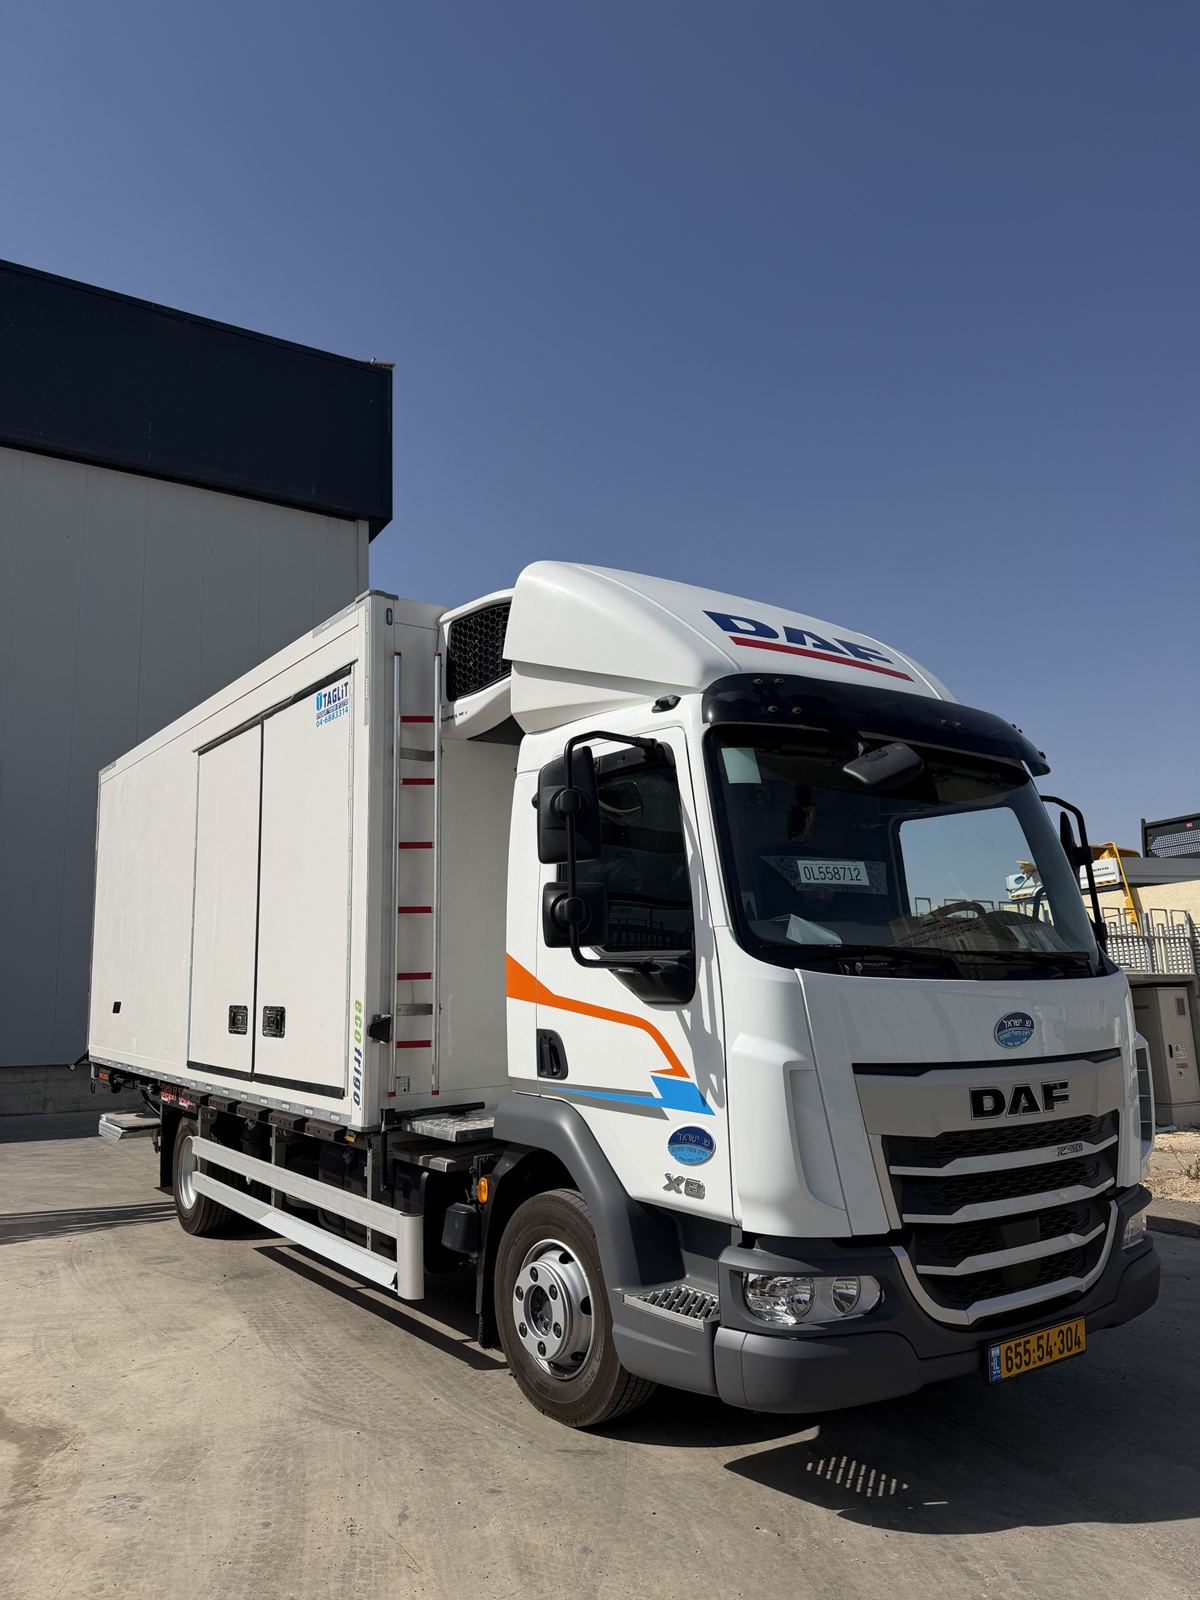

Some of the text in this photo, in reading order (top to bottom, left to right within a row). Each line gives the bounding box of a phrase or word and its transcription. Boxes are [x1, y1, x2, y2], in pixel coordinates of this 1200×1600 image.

[702, 610, 895, 665] DAF
[353, 1000, 362, 1106] eco frigo
[969, 1079, 1070, 1121] DAF
